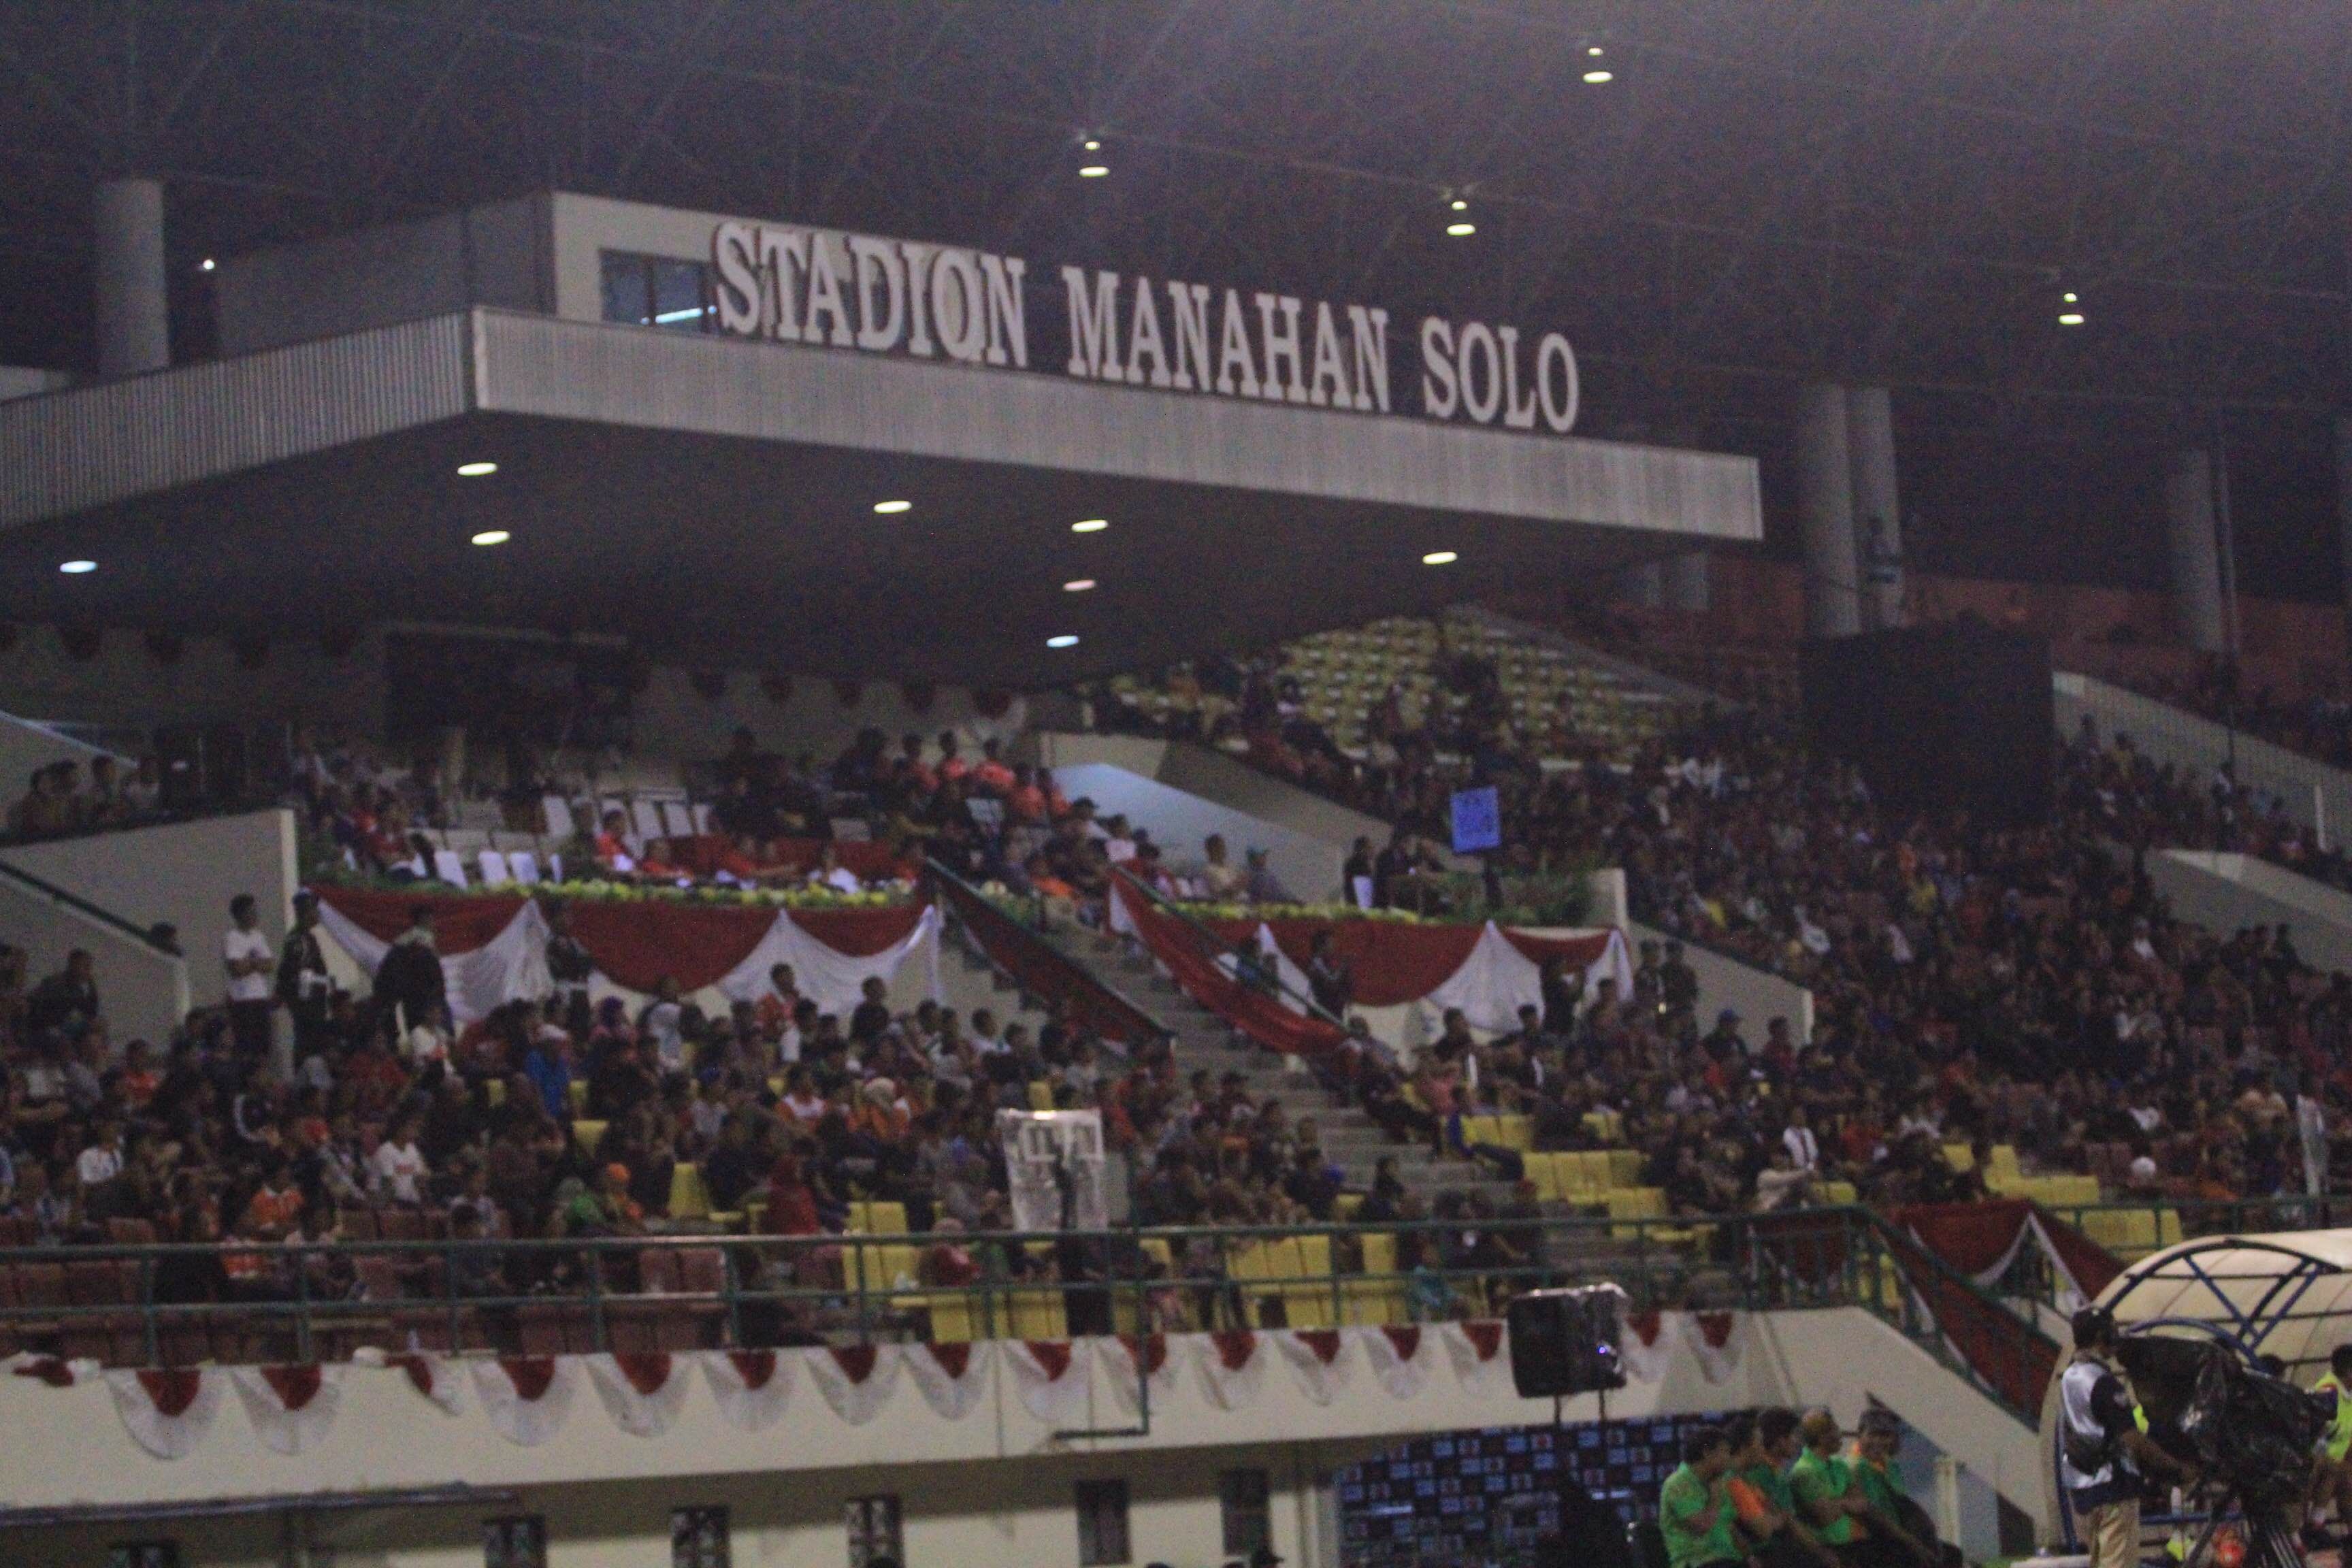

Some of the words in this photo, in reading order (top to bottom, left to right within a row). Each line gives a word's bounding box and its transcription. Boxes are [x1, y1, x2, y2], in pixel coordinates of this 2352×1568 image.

[715, 220, 1028, 368] STADION
[1062, 265, 1390, 412] MANAHAN
[1421, 315, 1580, 433] SOLO
